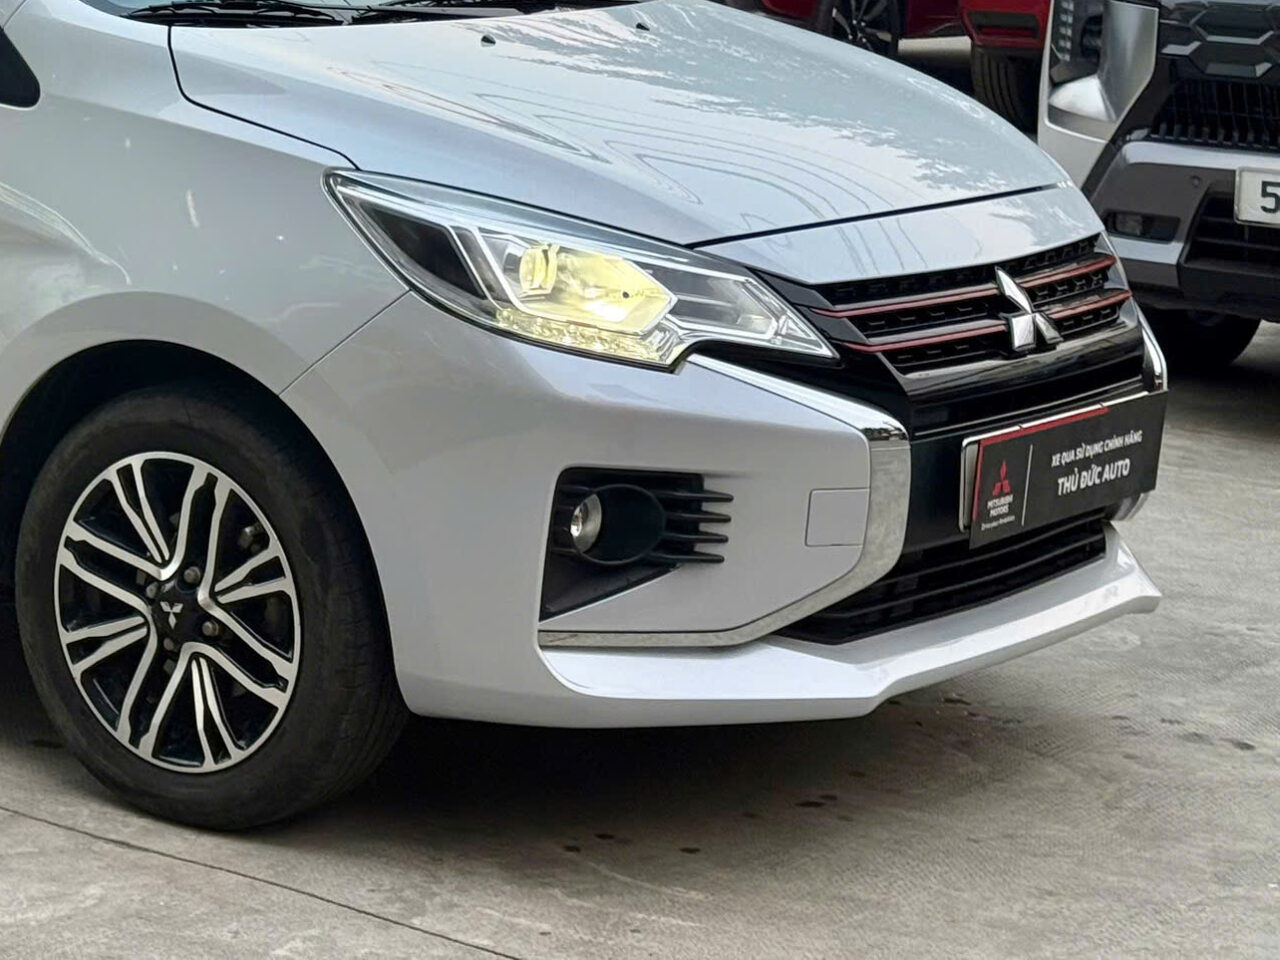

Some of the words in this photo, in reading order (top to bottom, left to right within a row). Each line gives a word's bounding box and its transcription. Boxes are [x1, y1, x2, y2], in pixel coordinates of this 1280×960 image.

[1051, 453, 1061, 467] XE
[1061, 449, 1076, 466] QUA
[1085, 441, 1104, 459] DỤNG
[1104, 434, 1125, 452] CHÍNH
[1124, 429, 1143, 446] HÃNG
[1057, 467, 1080, 496] THỦ
[1080, 463, 1103, 489] ĐỨC
[1102, 458, 1131, 483] AUTO
